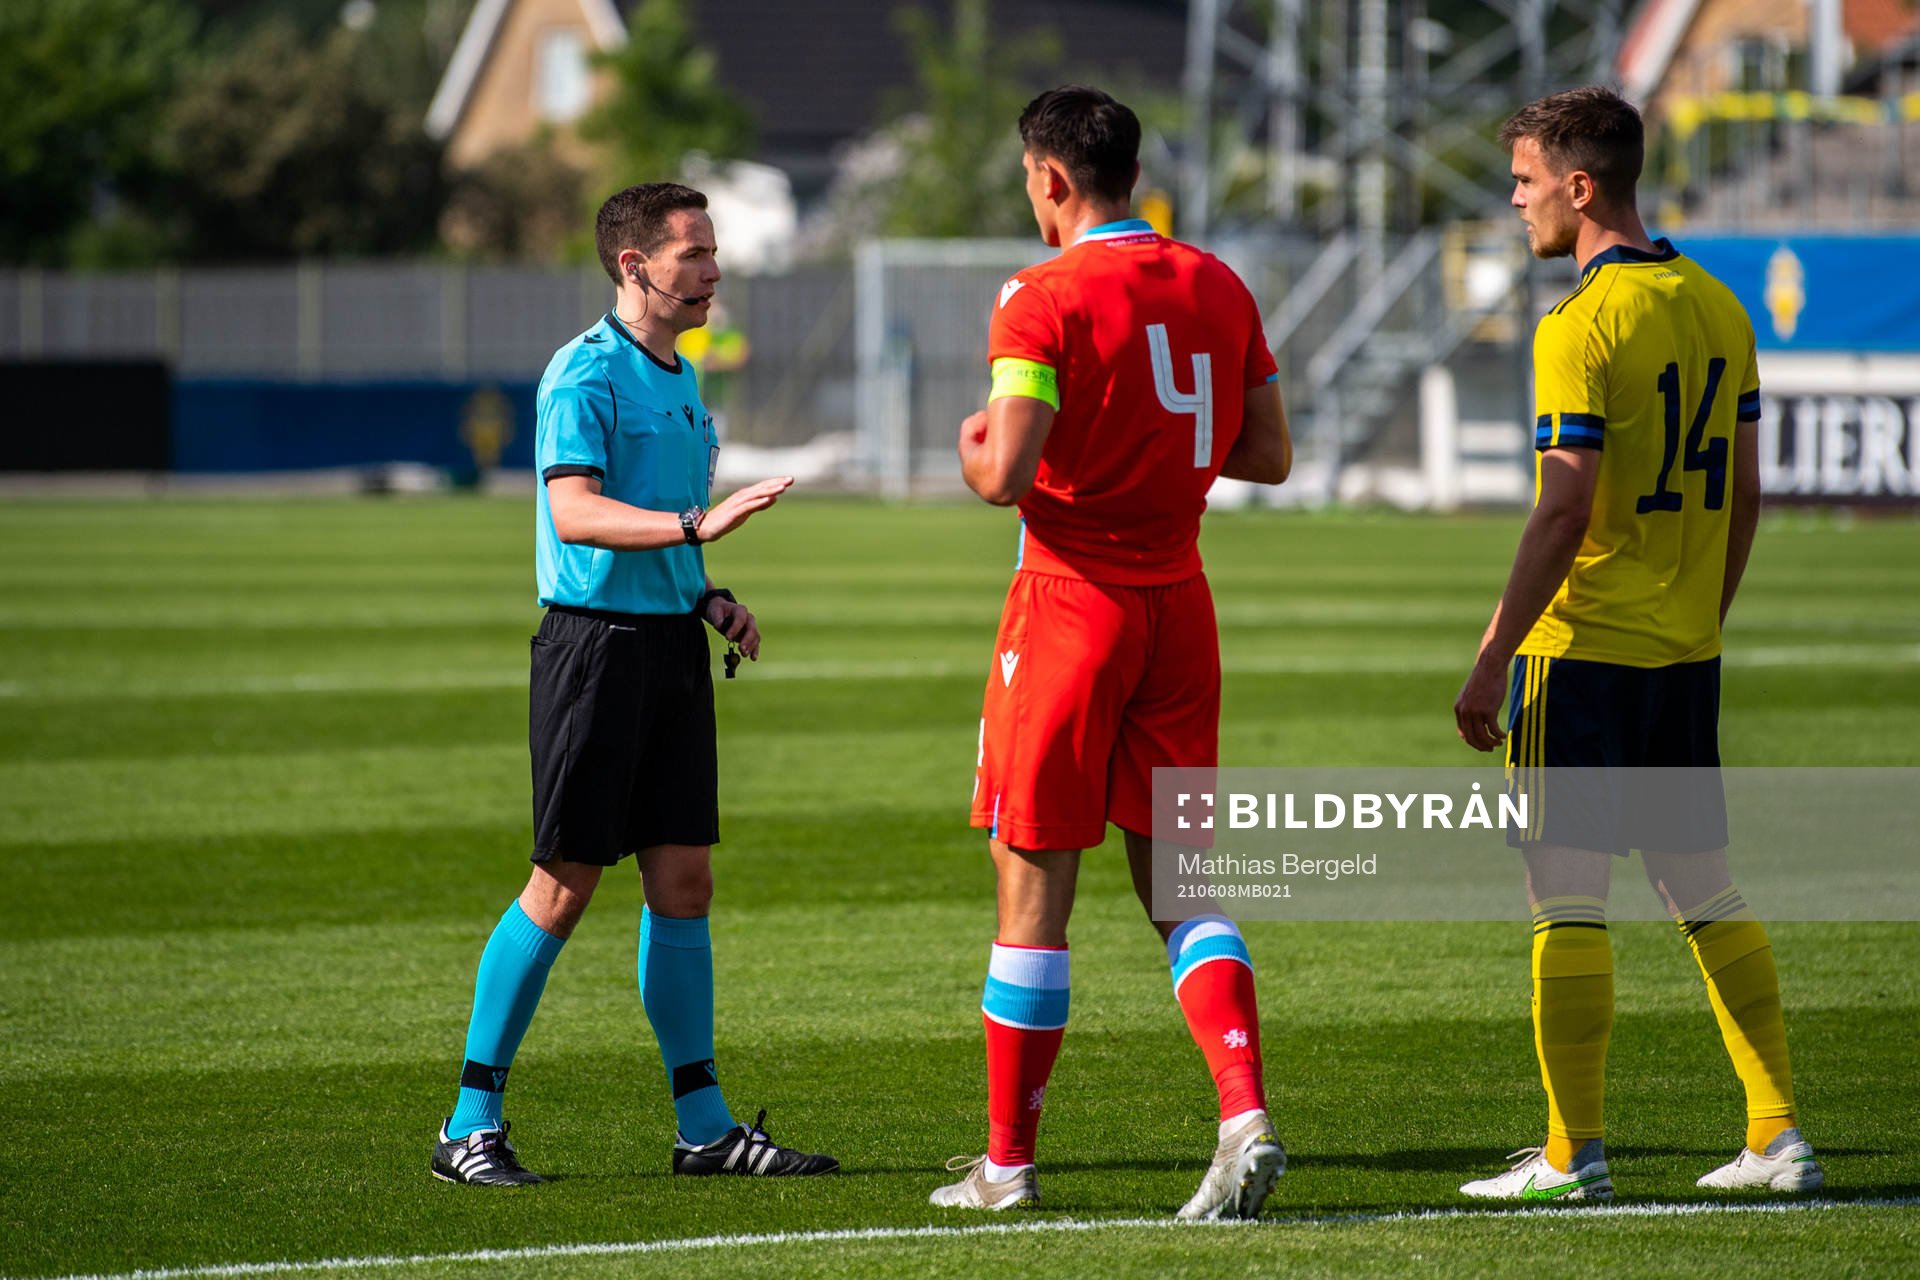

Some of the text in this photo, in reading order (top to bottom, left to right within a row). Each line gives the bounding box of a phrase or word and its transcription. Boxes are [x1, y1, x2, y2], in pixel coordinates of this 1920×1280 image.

[1146, 323, 1213, 468] 4
[1636, 357, 1729, 514] 14
[1758, 396, 1920, 496] LIER
